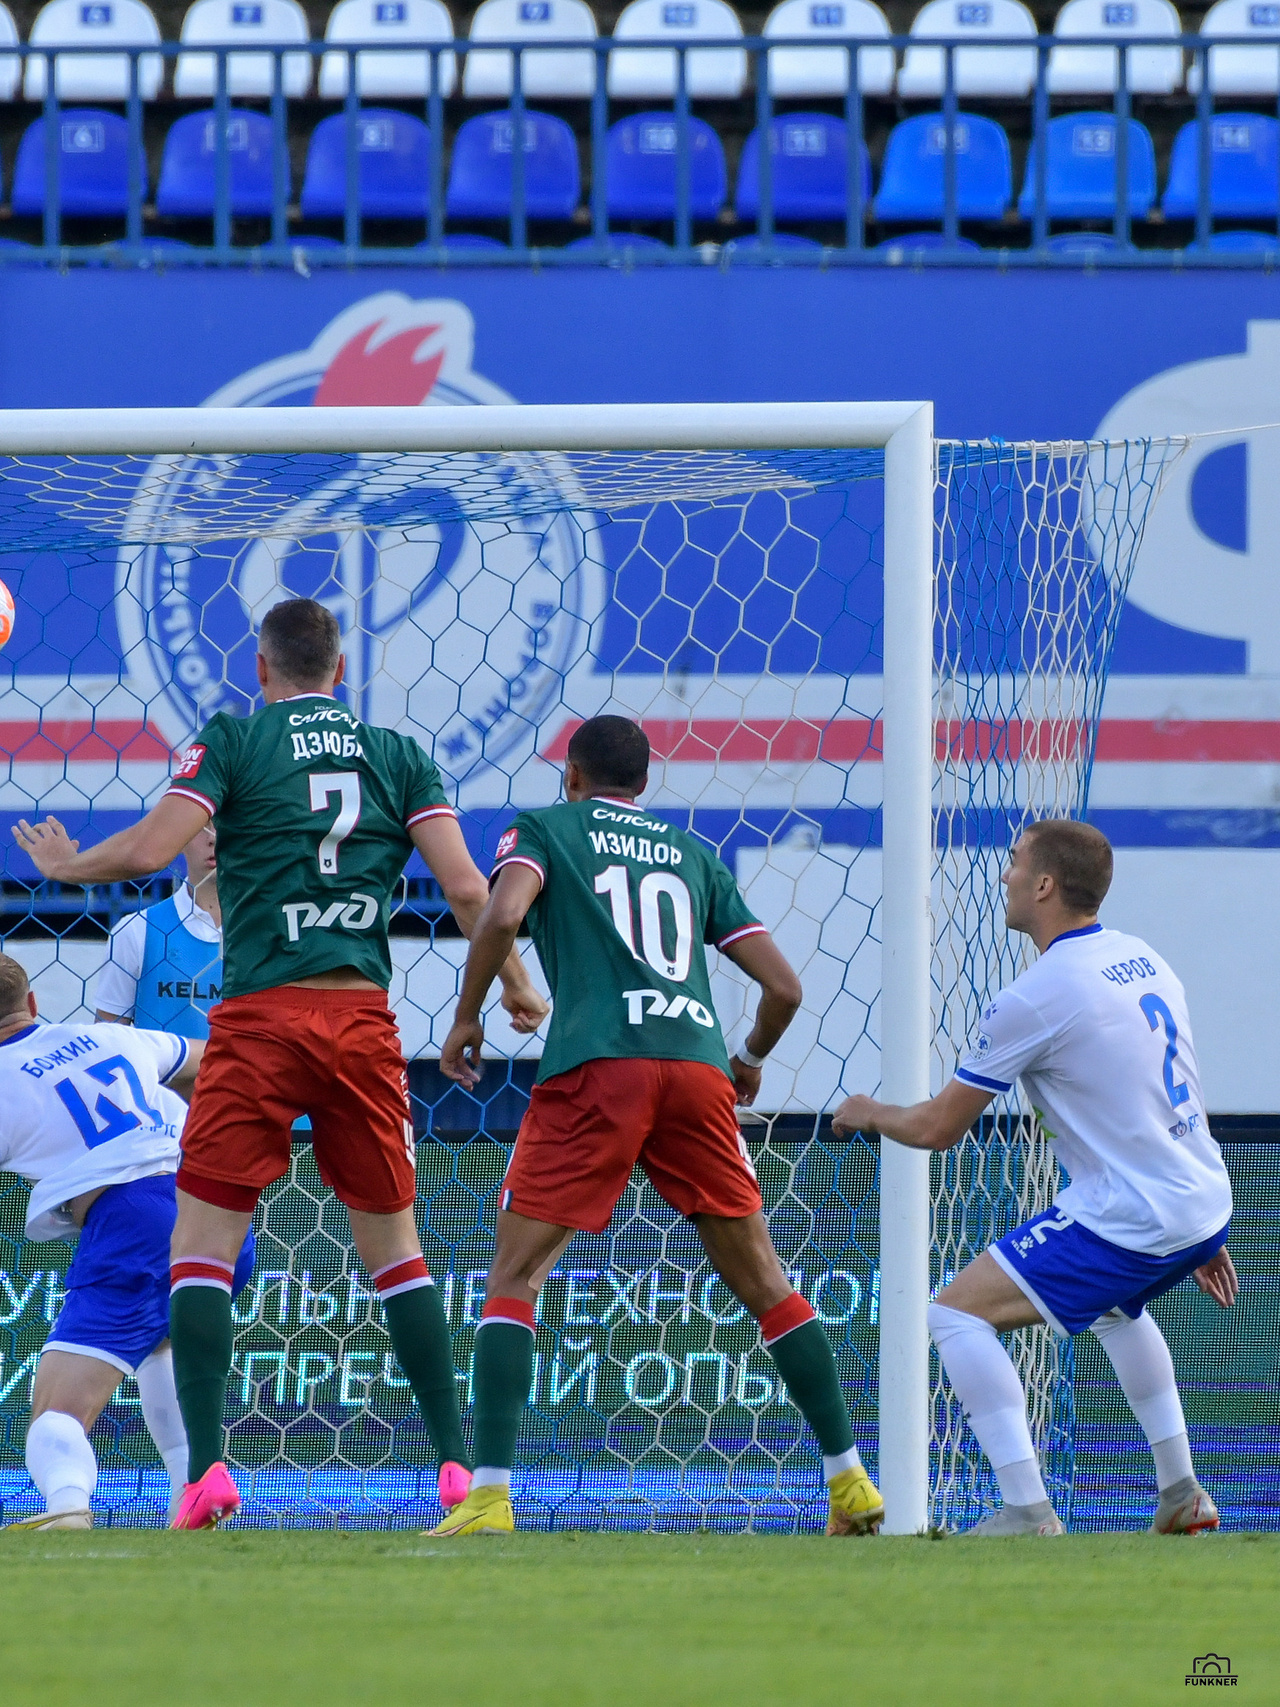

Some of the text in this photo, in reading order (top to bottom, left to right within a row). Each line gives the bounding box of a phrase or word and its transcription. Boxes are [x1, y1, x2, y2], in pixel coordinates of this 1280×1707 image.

[308, 771, 362, 876] 7
[588, 829, 683, 868] ИЗИДОР
[594, 864, 694, 983] 10
[157, 981, 223, 1000] KELM
[1100, 955, 1158, 987] ЧЕРОВ
[20, 1034, 100, 1080] БОЖИН
[1138, 991, 1192, 1110] 2
[53, 1053, 165, 1151] 47
